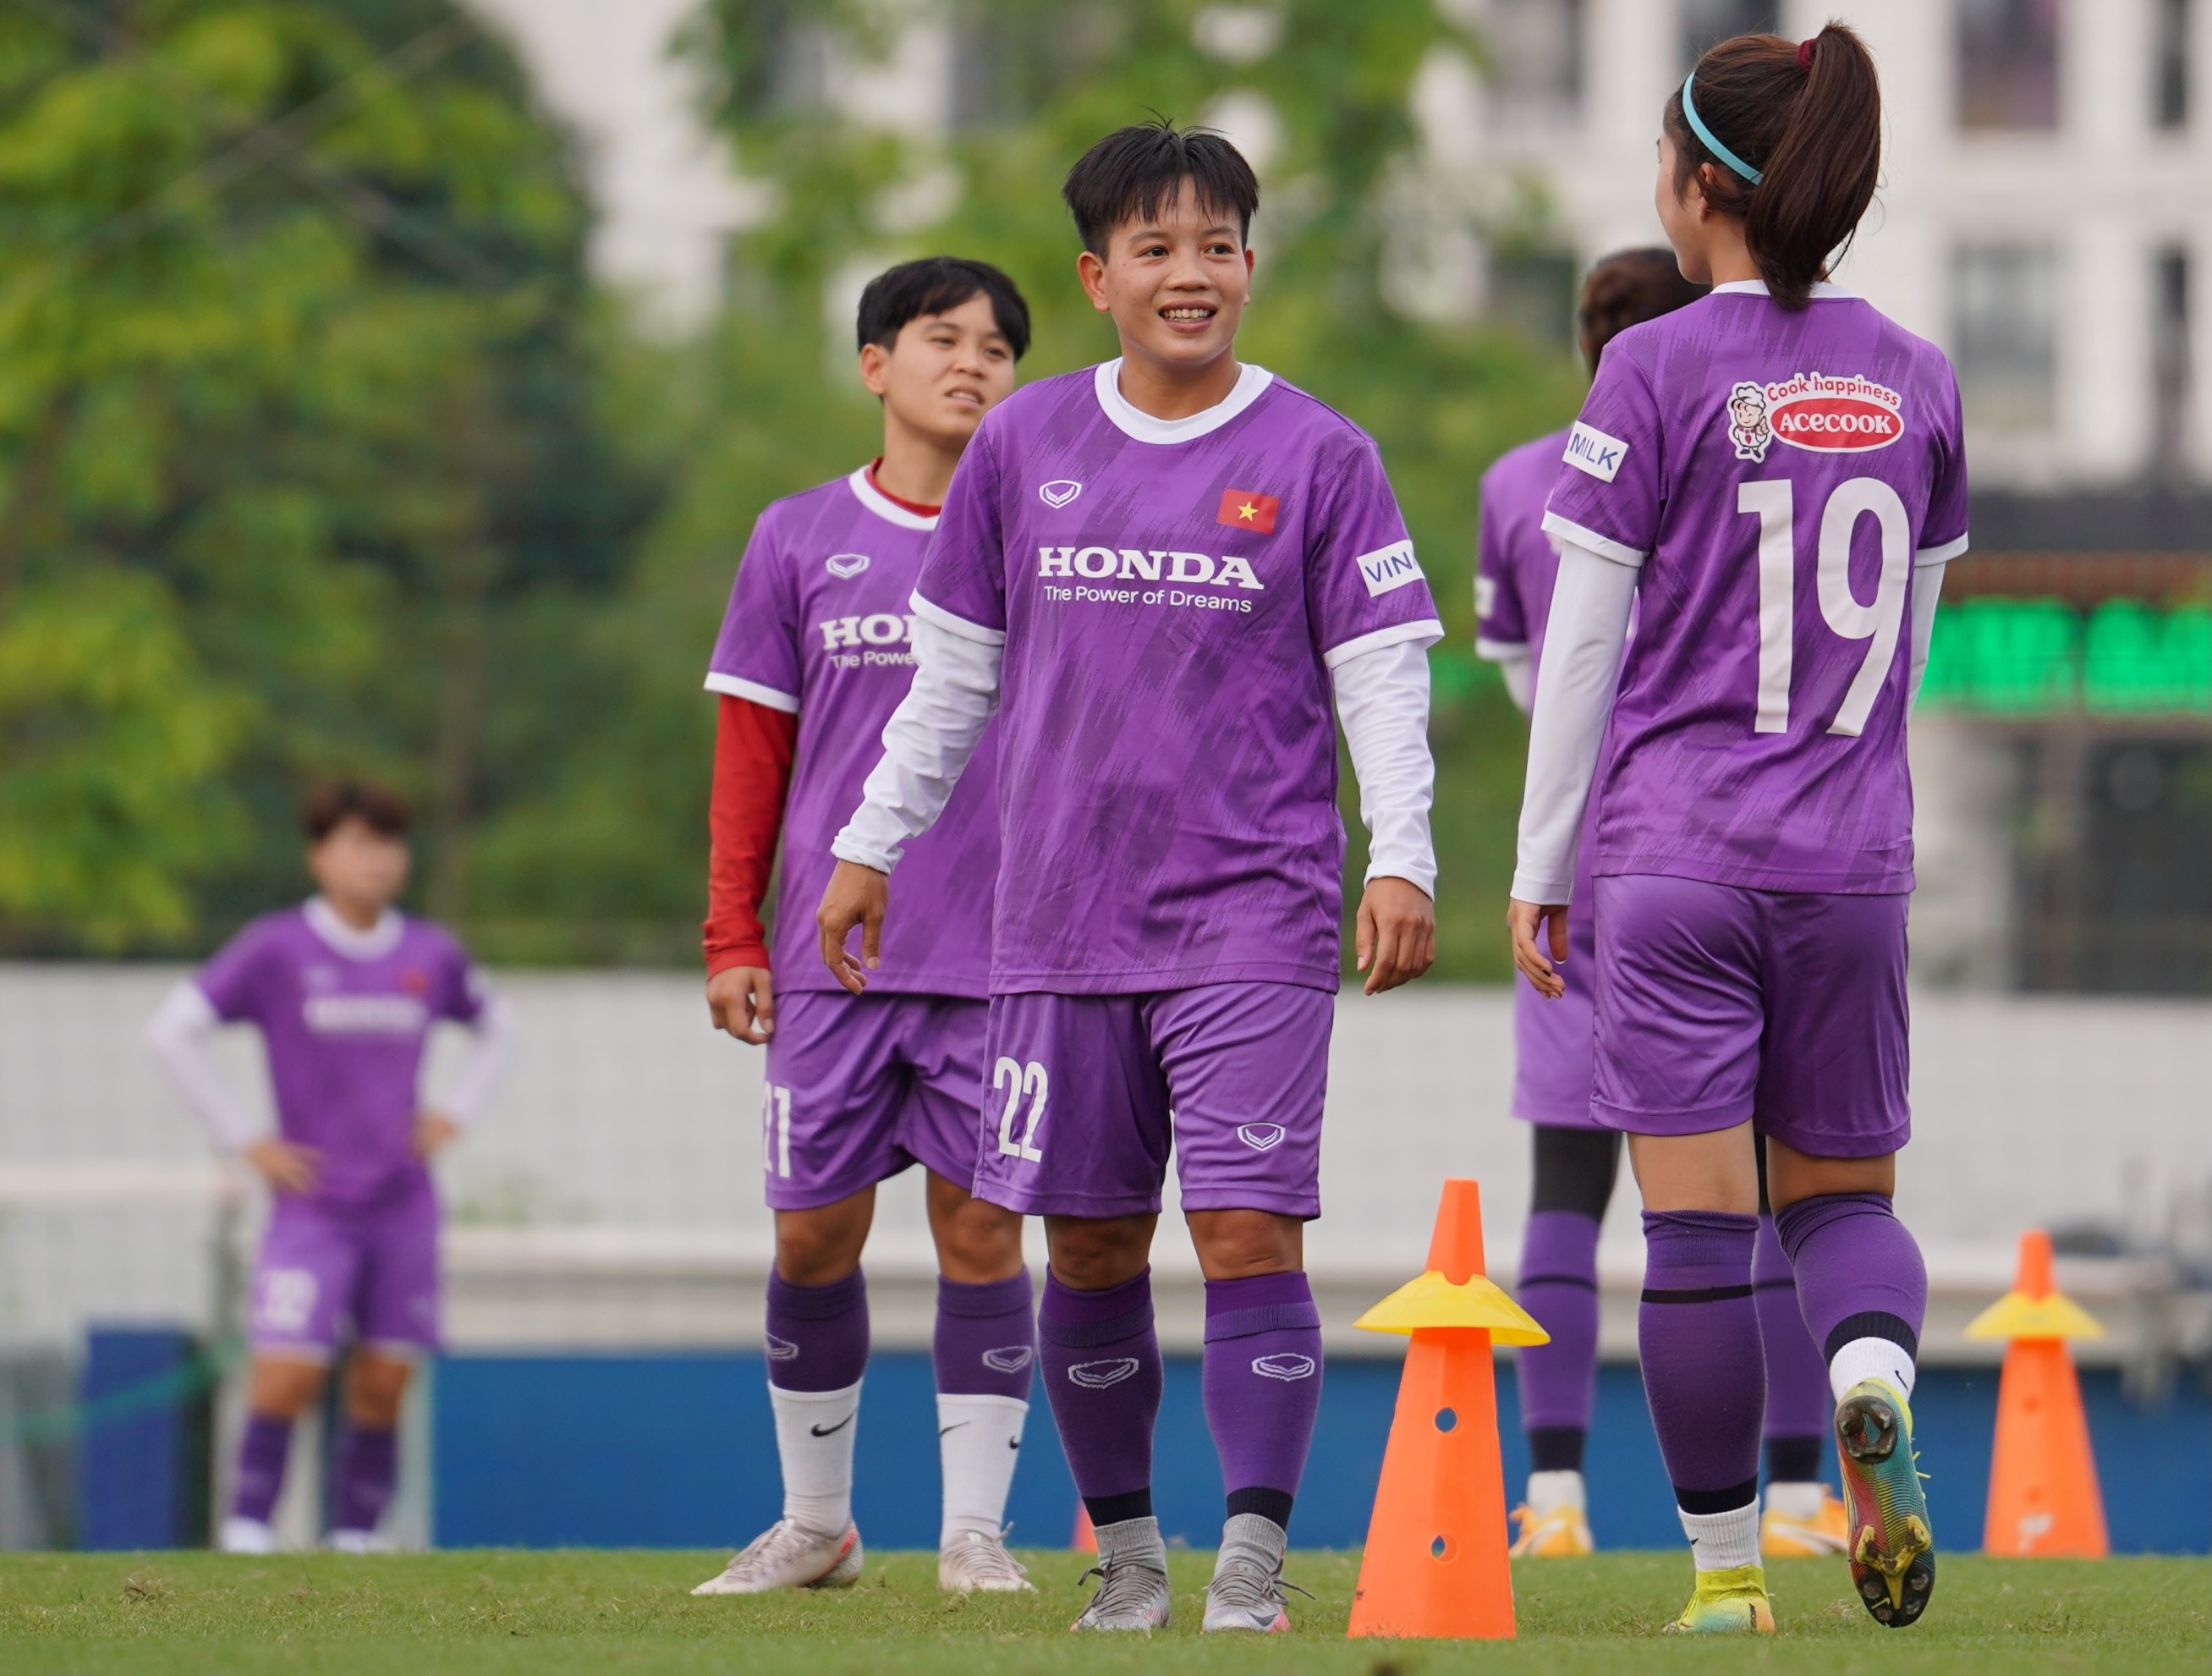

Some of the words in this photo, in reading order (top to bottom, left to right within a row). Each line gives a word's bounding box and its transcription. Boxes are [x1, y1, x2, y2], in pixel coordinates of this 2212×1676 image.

[1767, 377, 1809, 402] Cook
[1814, 376, 1899, 406] happiness
[1569, 432, 1618, 471] MILK
[1038, 546, 1265, 591] HONDA
[1044, 585, 1072, 602] The
[1075, 585, 1139, 604] Power
[1142, 589, 1165, 605] of
[1169, 590, 1253, 613] Dreams
[1737, 476, 1911, 738] 19
[830, 654, 860, 668] The
[993, 1056, 1048, 1163] 22
